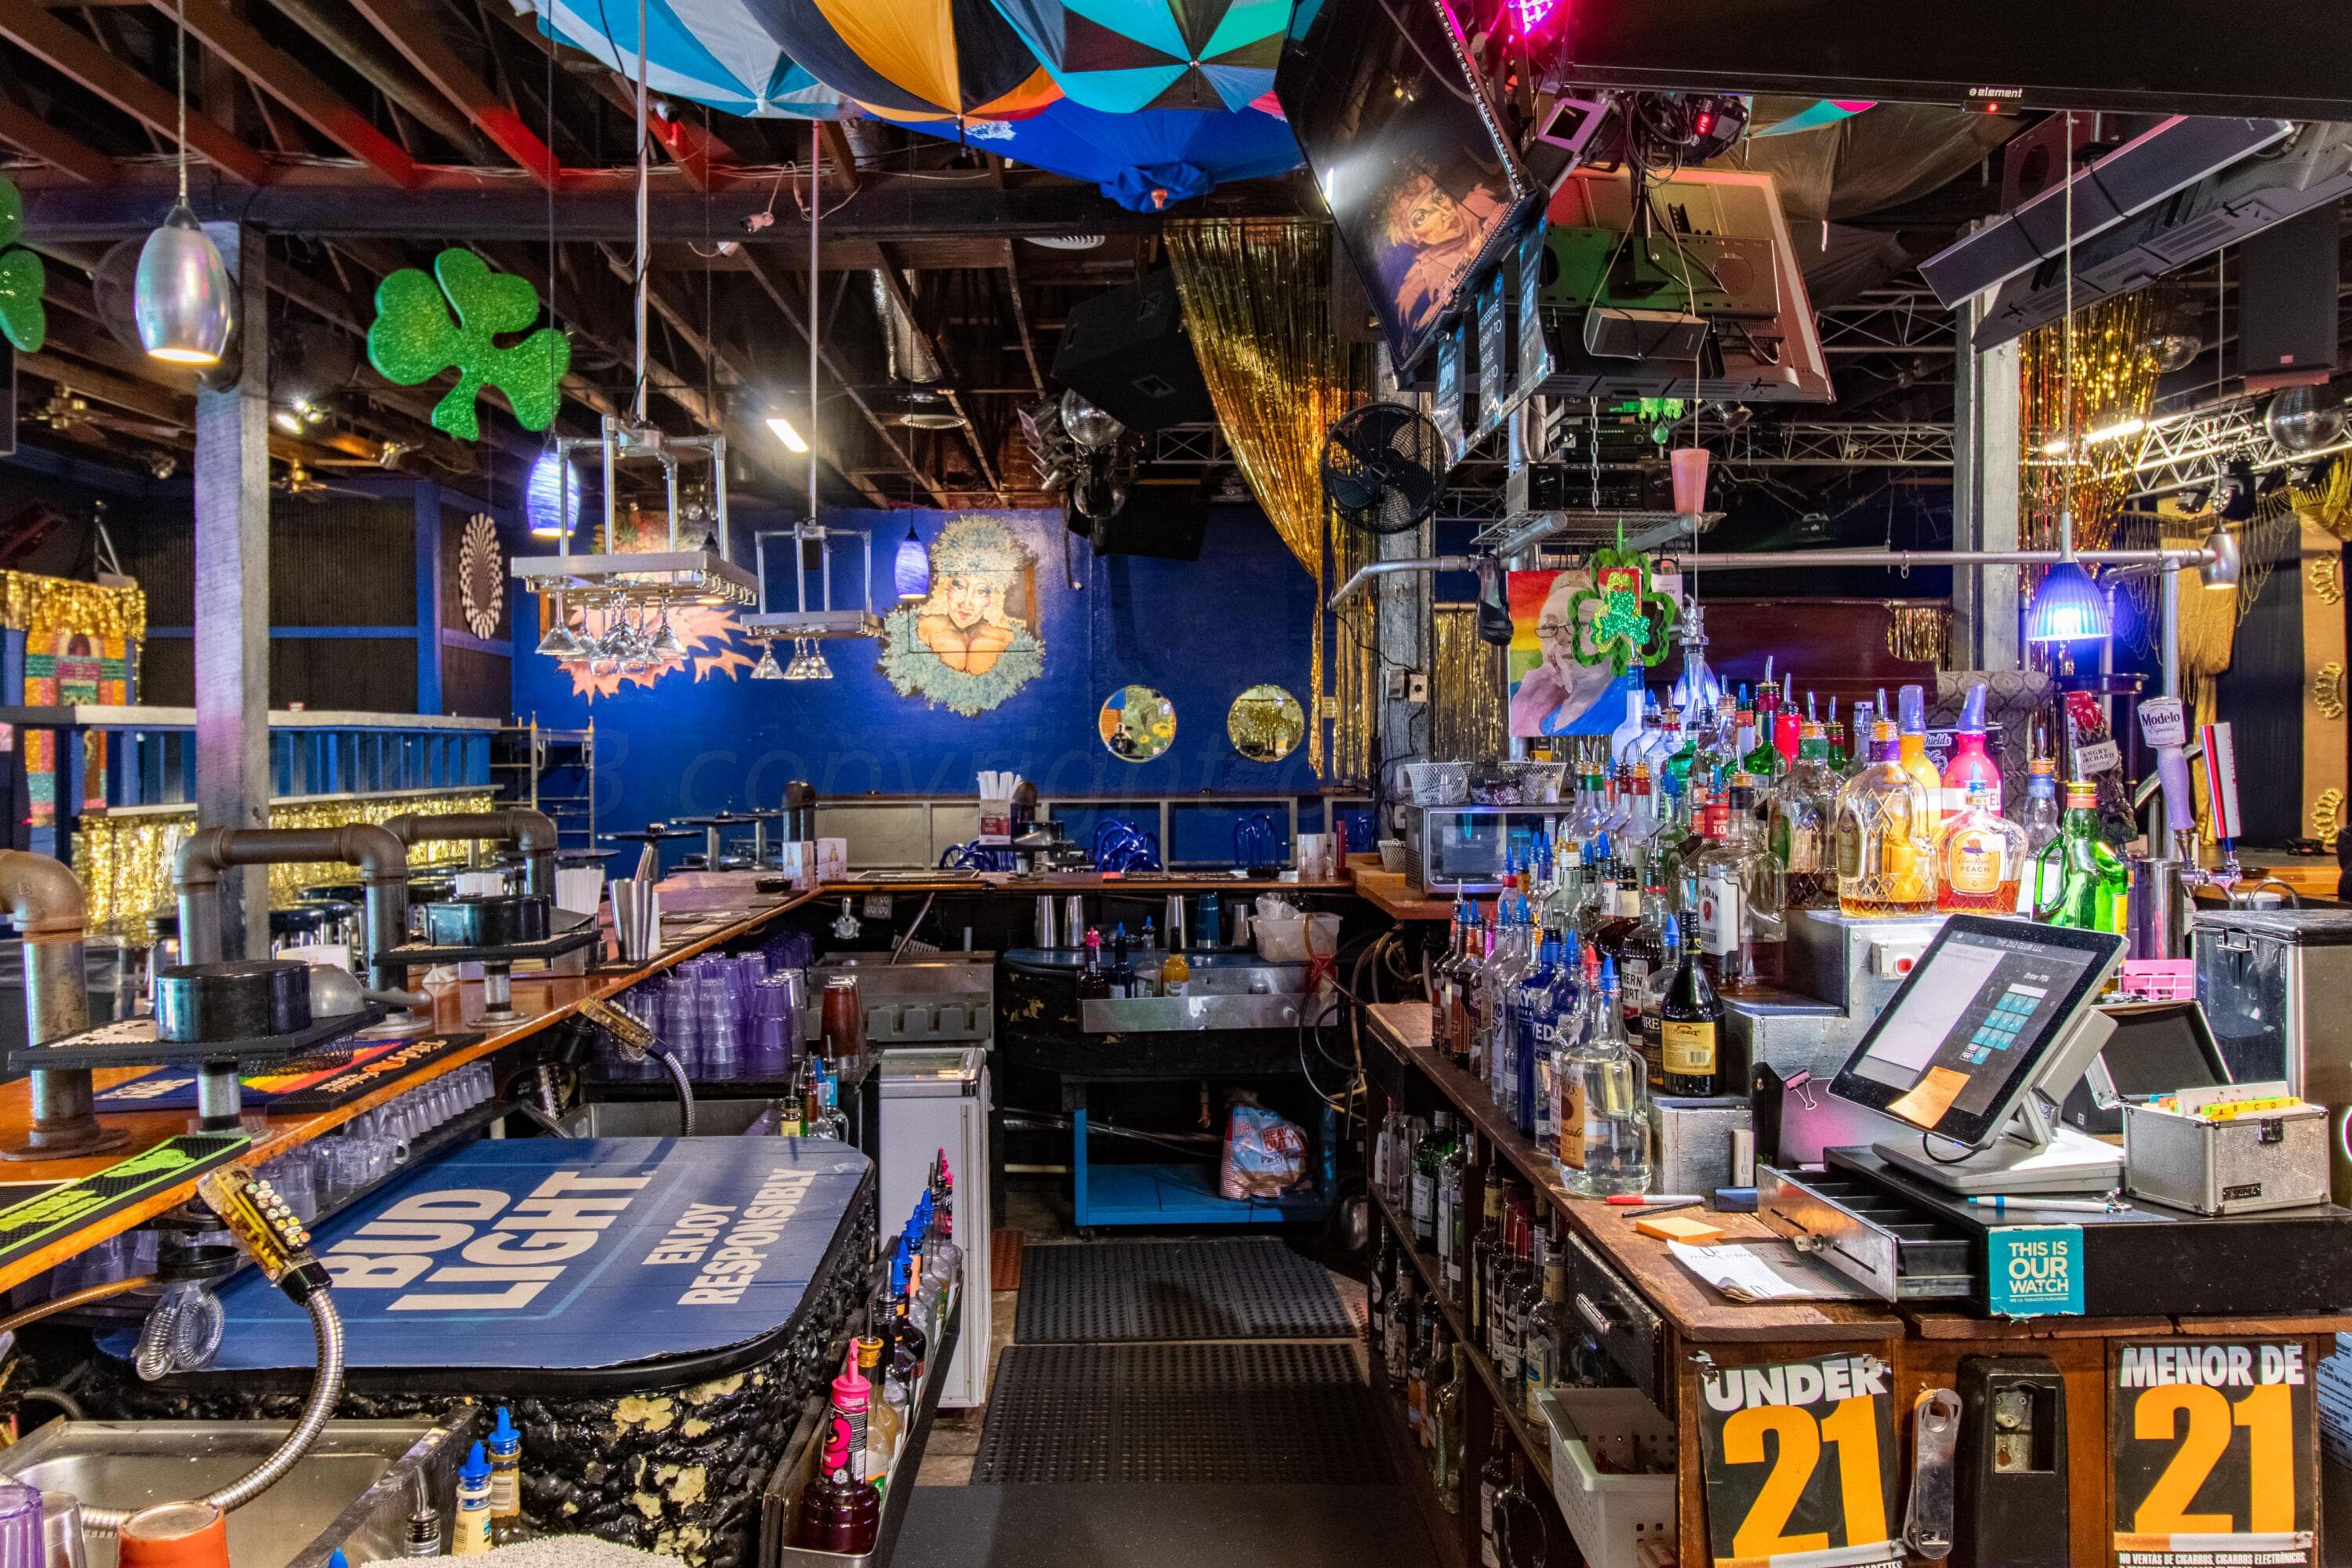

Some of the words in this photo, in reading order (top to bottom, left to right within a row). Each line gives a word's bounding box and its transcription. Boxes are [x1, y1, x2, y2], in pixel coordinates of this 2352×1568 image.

[1977, 86, 2023, 98] element
[1494, 319, 1501, 334] TO
[2141, 711, 2180, 728] Modelo
[2082, 746, 2108, 758] ANGRY
[1705, 884, 1720, 906] BEAM
[2018, 942, 2033, 951] CLUB
[2032, 944, 2045, 953] LLC
[2024, 971, 2039, 981] Enter
[318, 1189, 510, 1288] BUD
[387, 1171, 652, 1311] LIGHT
[641, 1203, 738, 1265] ENJOY
[677, 1168, 818, 1305] RESPONSIBLY
[2008, 1242, 2049, 1257] THIS
[2052, 1240, 2068, 1256] IS
[2009, 1257, 2068, 1279] OUR
[2009, 1278, 2069, 1294] WATCH
[2120, 1345, 2252, 1388] MENOR
[2260, 1345, 2305, 1386] DE
[1704, 1356, 1889, 1412] UNDER
[2134, 1383, 2296, 1534] 21
[1722, 1394, 1889, 1559] 21
[2119, 1553, 2130, 1565] NO
[2132, 1553, 2162, 1565] VENTAS
[2164, 1553, 2174, 1565] DE
[2215, 1553, 2252, 1565] CIGARROS
